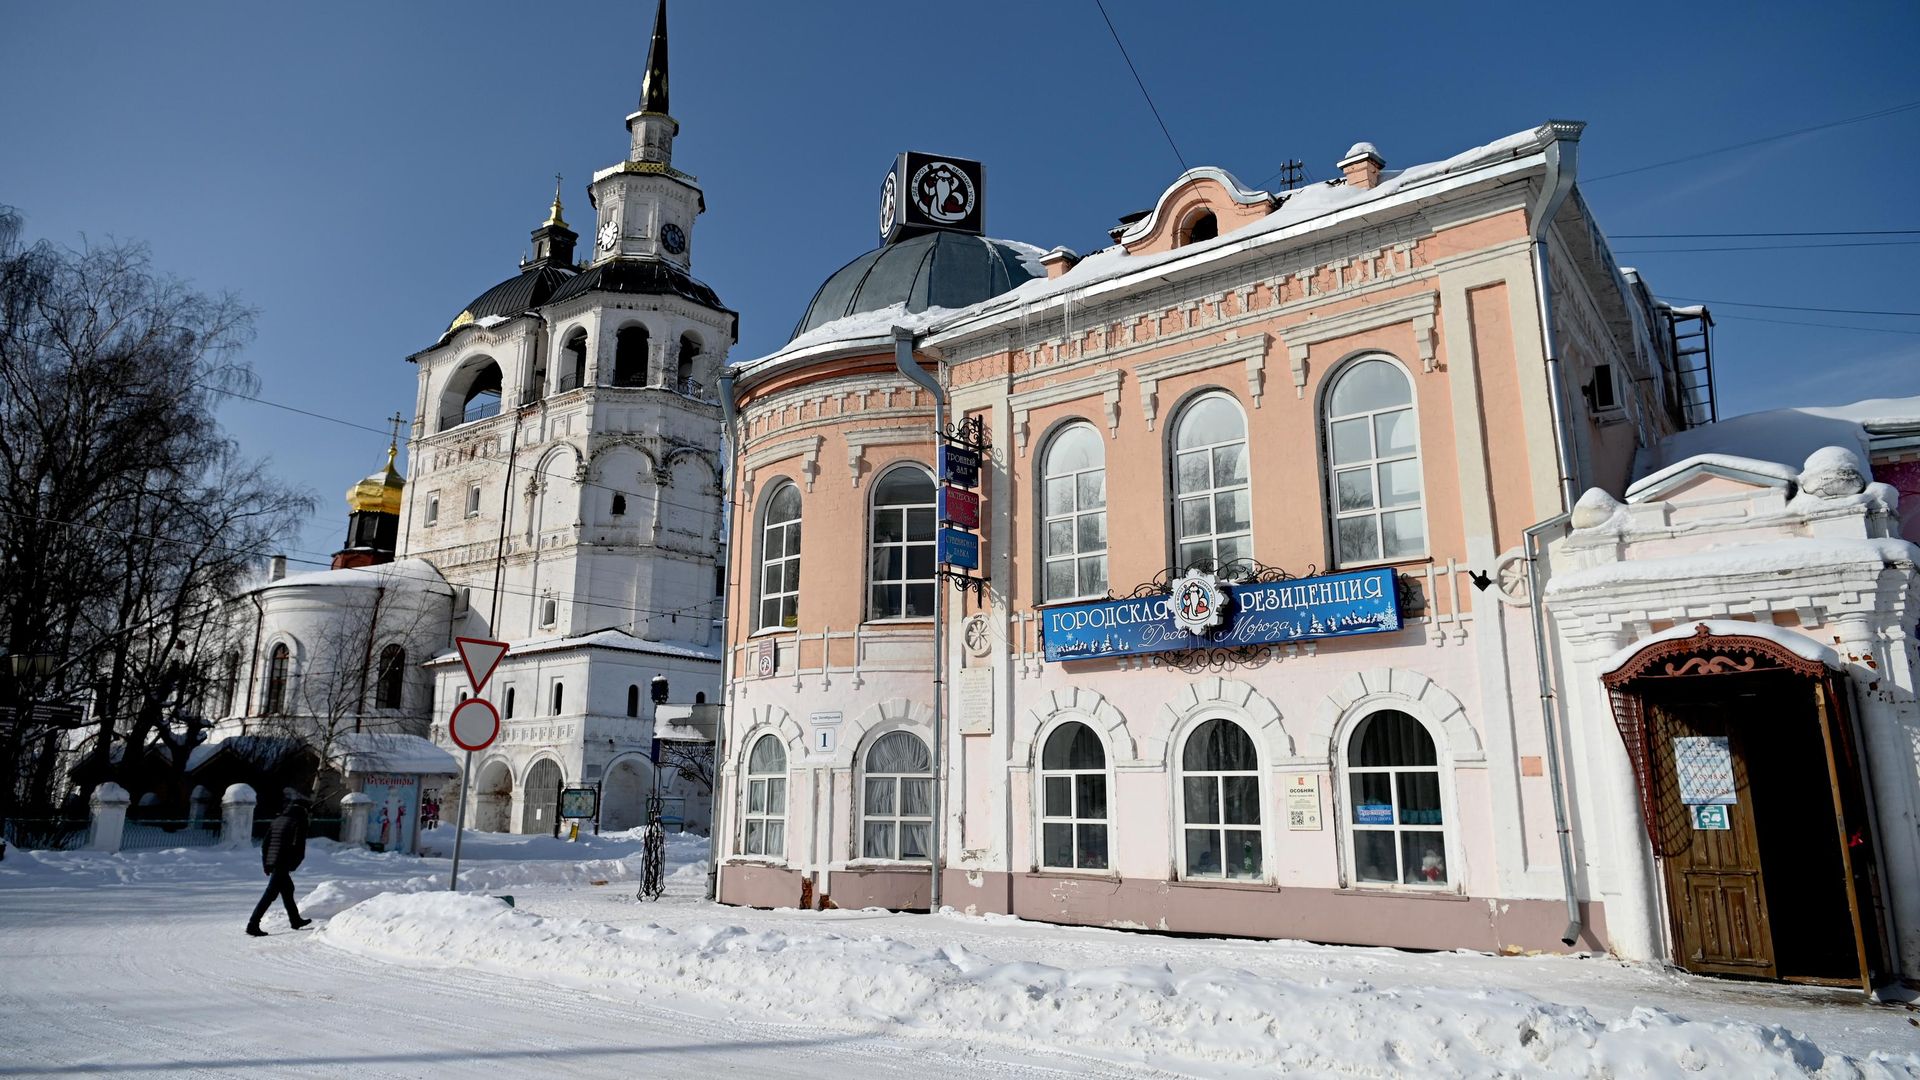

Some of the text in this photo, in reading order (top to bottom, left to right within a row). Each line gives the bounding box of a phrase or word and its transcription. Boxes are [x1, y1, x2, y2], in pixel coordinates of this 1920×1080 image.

[913, 167, 927, 184] МОРОЗ
[1051, 575, 1384, 633] ГОРОДСКАЯ РЕЗИДЕНЦИЯ
[1137, 615, 1290, 647] Деда Мороза
[821, 732, 827, 747] 1
